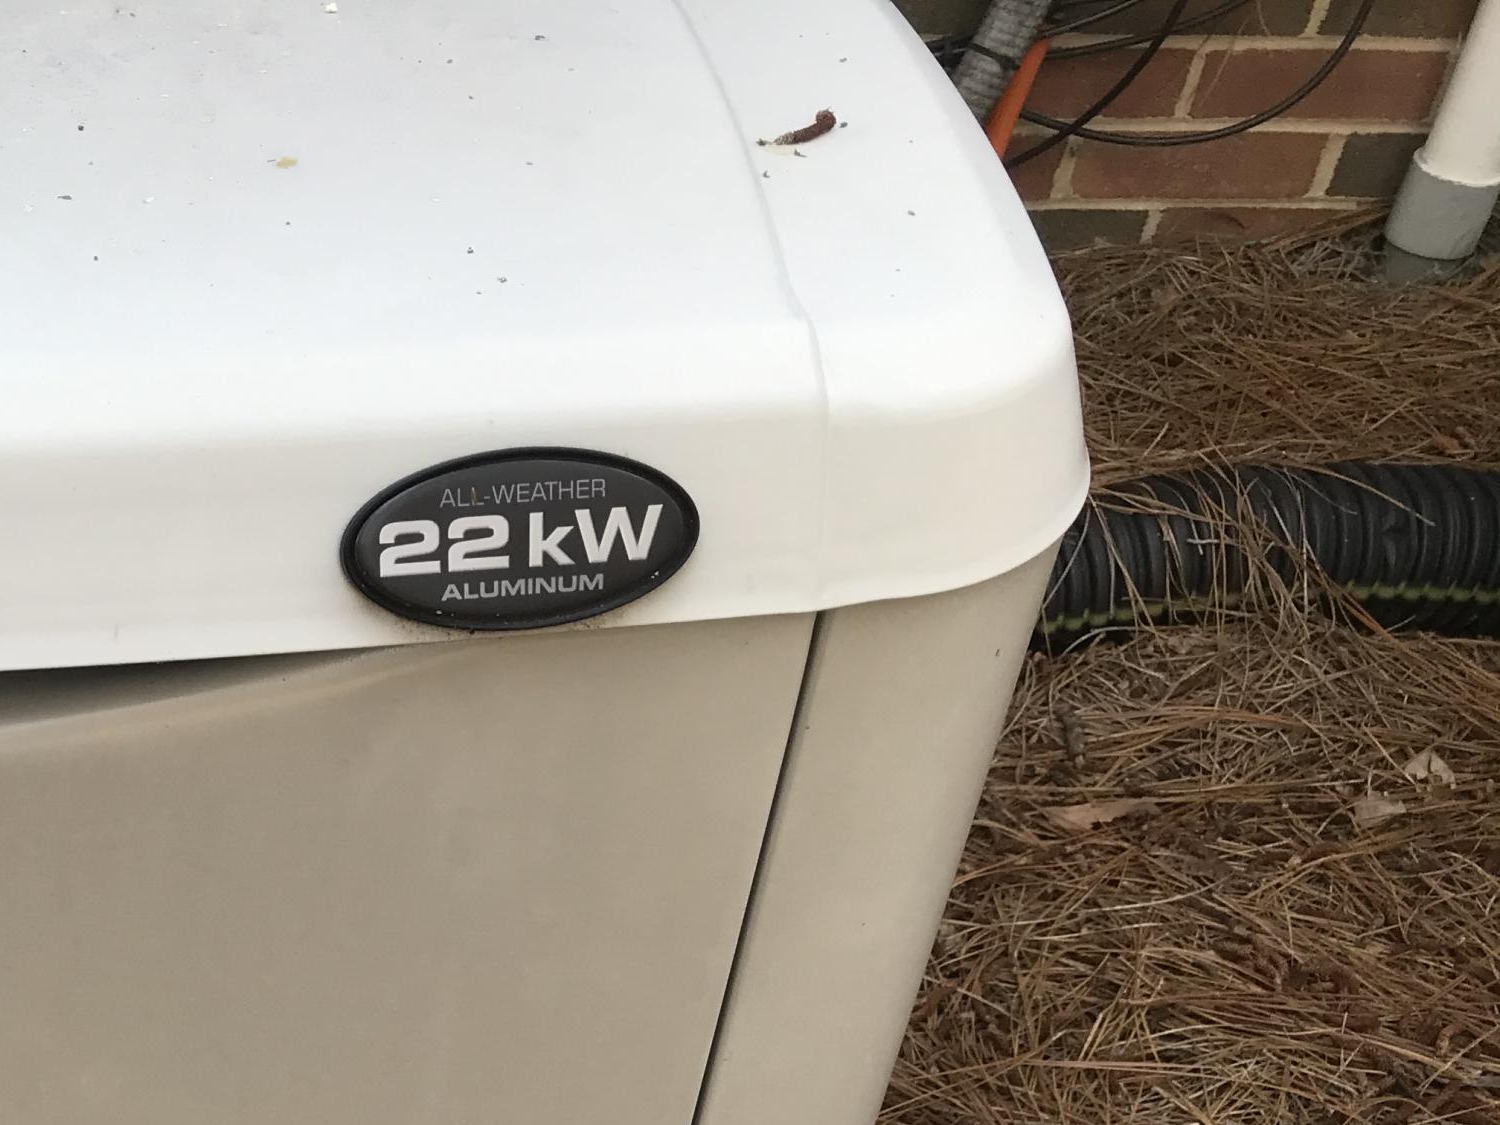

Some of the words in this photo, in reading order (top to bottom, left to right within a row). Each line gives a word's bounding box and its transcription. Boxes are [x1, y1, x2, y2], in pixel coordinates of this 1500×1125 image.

[439, 478, 606, 509] ALL-WEATHER
[378, 514, 511, 578] 22
[528, 503, 664, 568] kW
[440, 573, 605, 602] ALUMINUM
